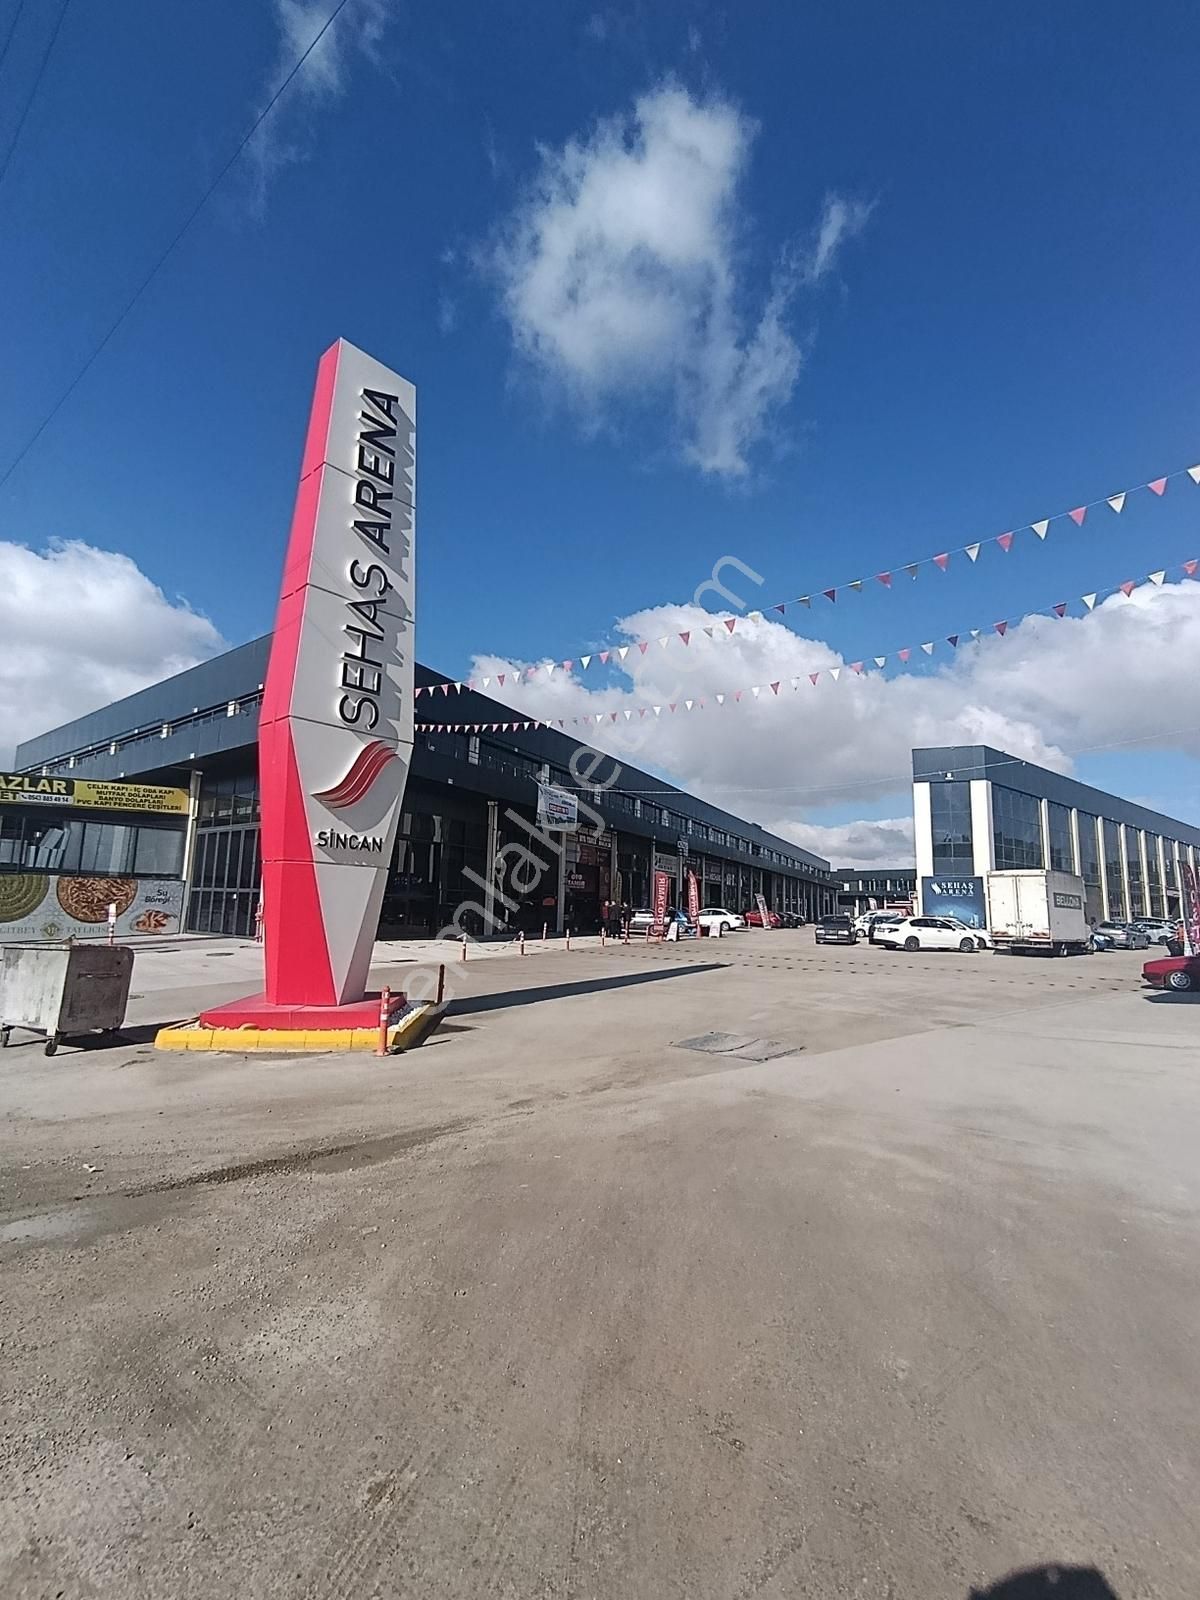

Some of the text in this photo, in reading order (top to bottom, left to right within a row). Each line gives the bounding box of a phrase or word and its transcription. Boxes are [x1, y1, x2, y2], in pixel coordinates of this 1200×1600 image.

[339, 387, 400, 731] SEHAŞ ARENA
[127, 792, 166, 800] DOLAPLARI
[113, 801, 146, 809] PENCERE
[125, 797, 164, 805] DOLAPLARI
[317, 828, 383, 853] SİNCAN
